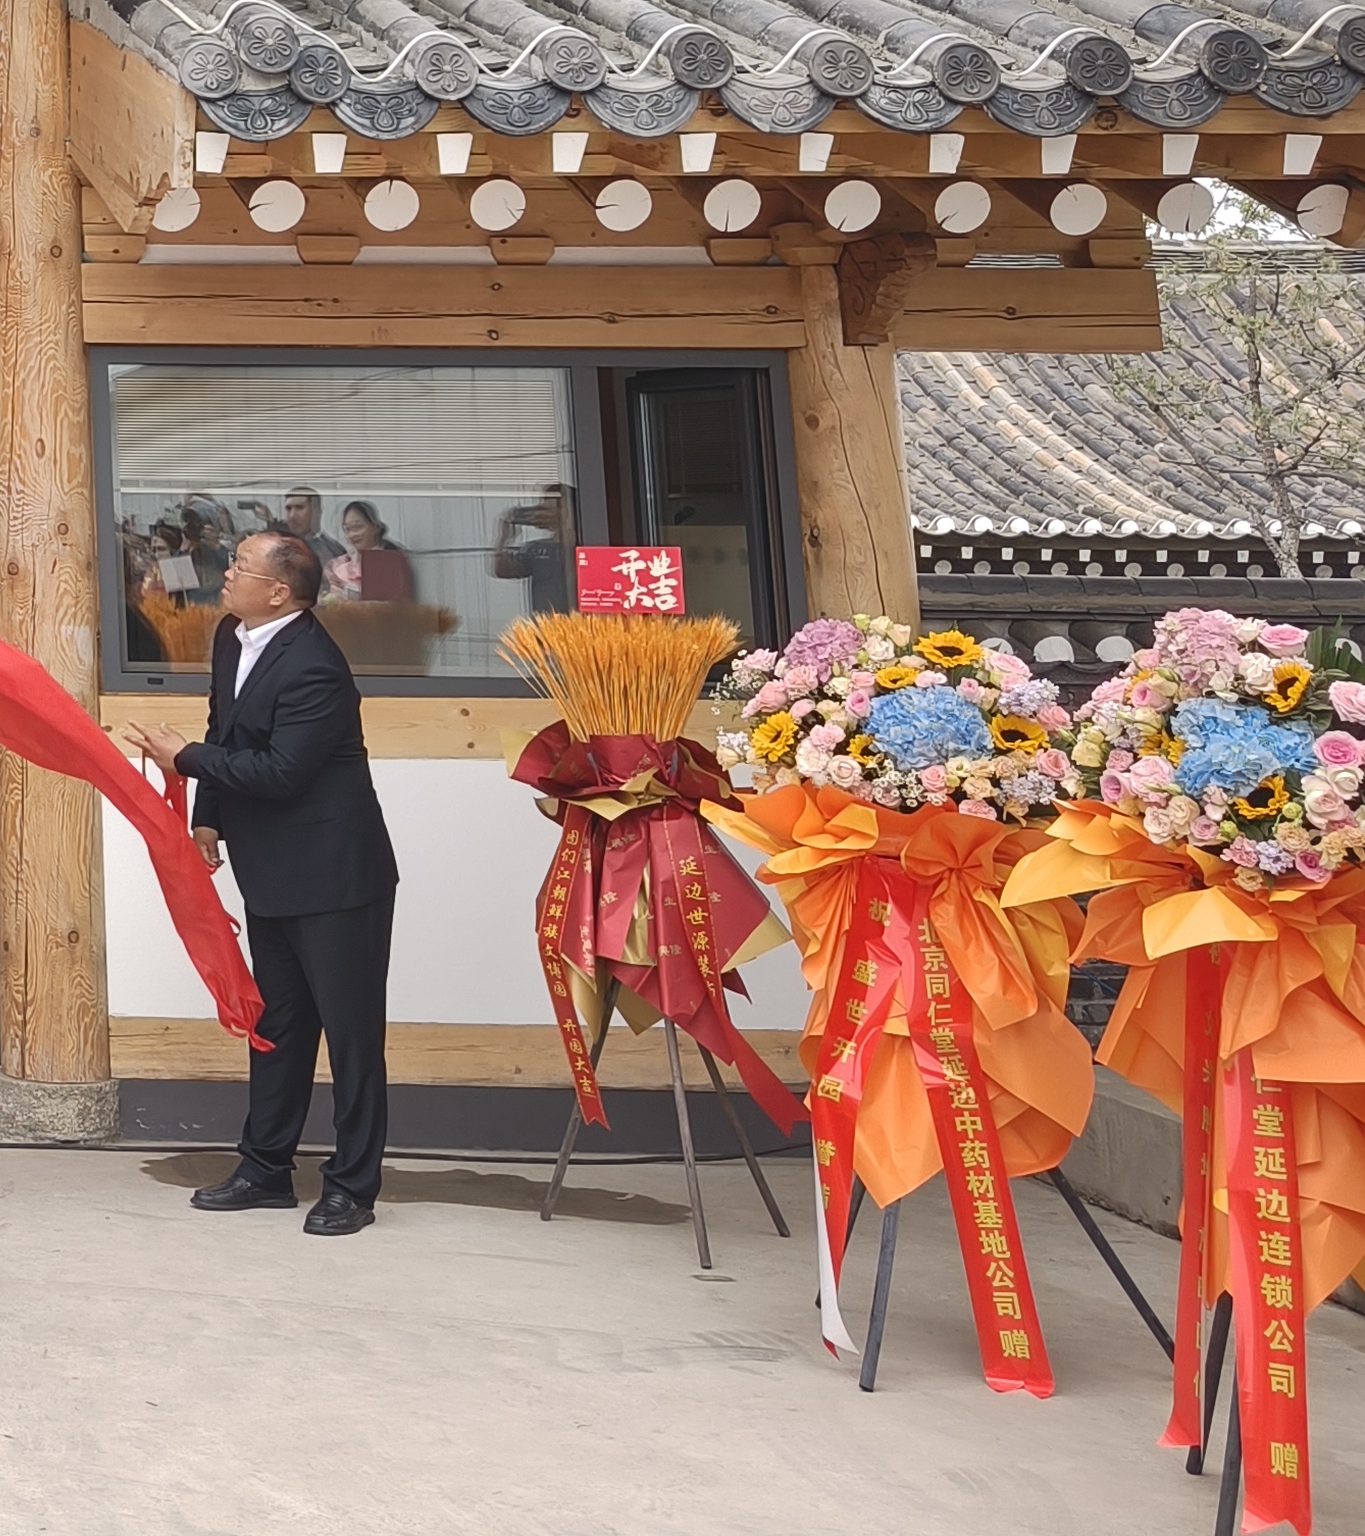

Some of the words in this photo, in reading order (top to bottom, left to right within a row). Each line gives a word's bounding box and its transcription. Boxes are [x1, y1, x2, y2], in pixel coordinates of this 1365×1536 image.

[611, 549, 680, 582] 开业
[623, 575, 679, 611] 大吉
[563, 1018, 593, 1094] 开园大吉
[999, 1328, 1031, 1362] 赠
[1269, 1442, 1300, 1480] 赠
